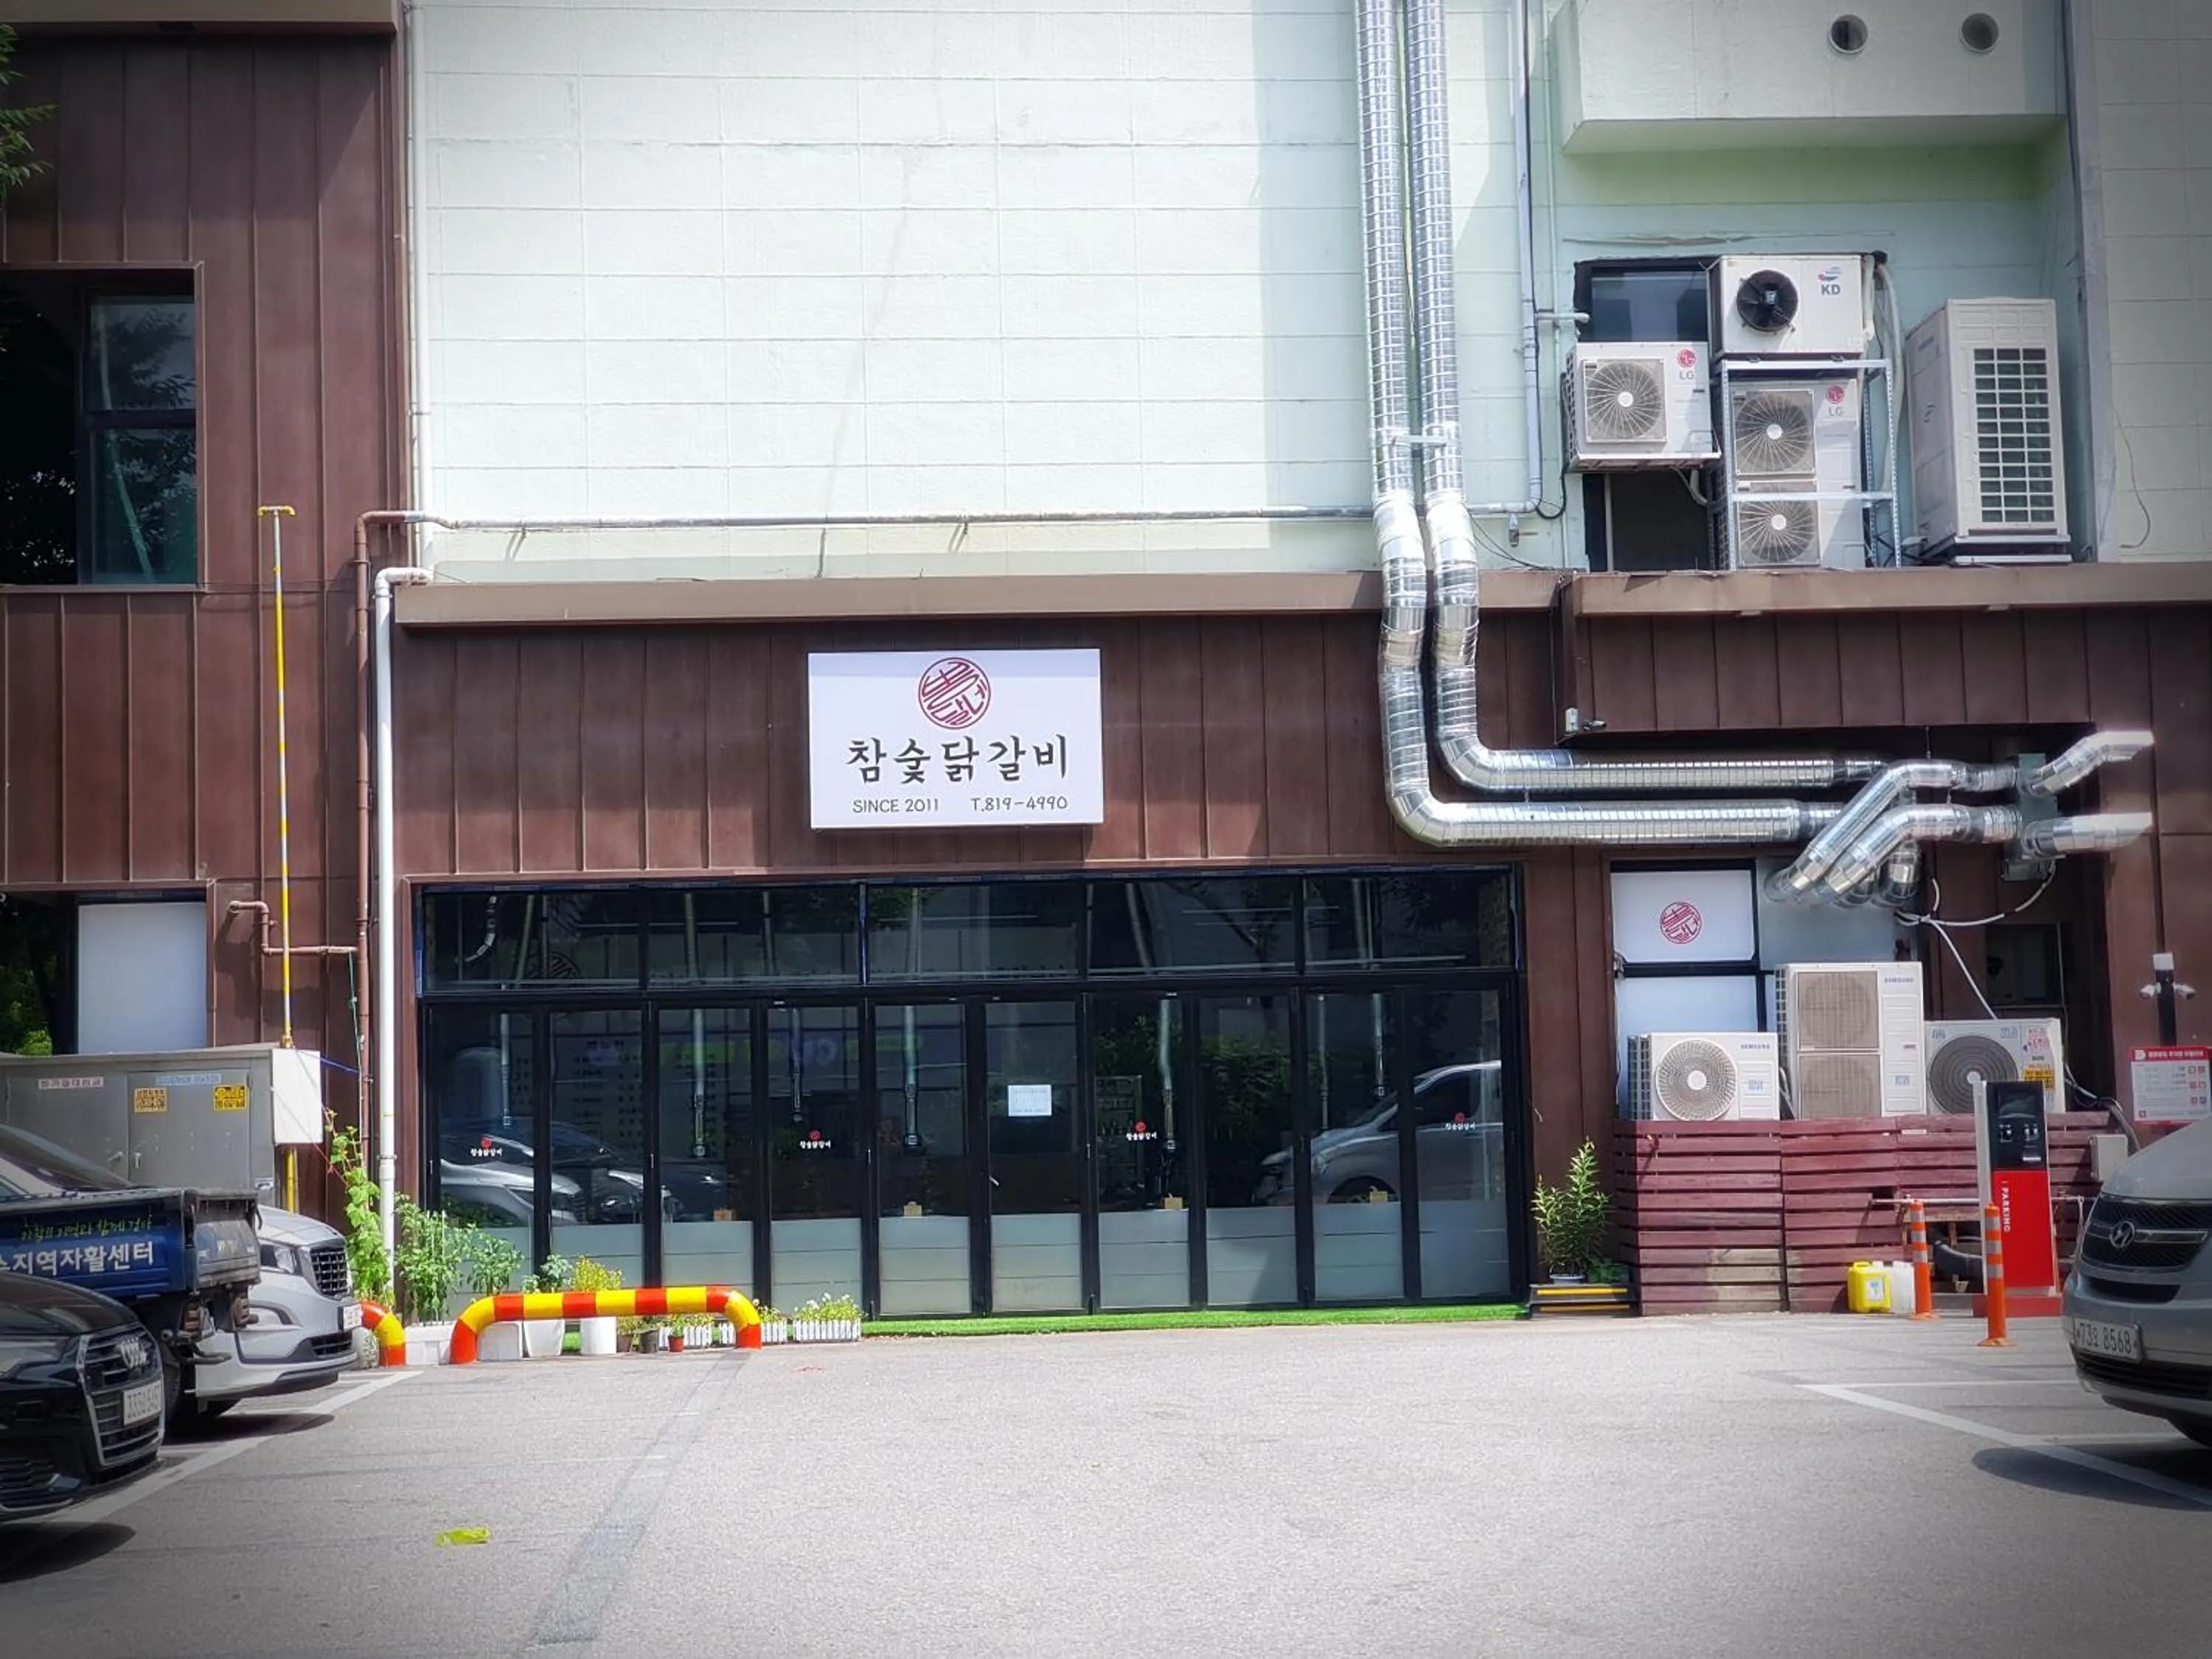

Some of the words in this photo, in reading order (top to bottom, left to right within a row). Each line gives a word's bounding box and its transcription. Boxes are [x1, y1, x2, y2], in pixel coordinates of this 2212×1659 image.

[1821, 285, 1841, 295] KD
[1680, 372, 1694, 380] LG
[1829, 407, 1843, 417] LG
[847, 734, 1069, 785] 참숯닭갈비
[852, 799, 900, 813] SINCE
[905, 798, 939, 813] 2011
[970, 796, 1068, 813] T.819-4990
[2001, 1187, 2011, 1232] PARKING
